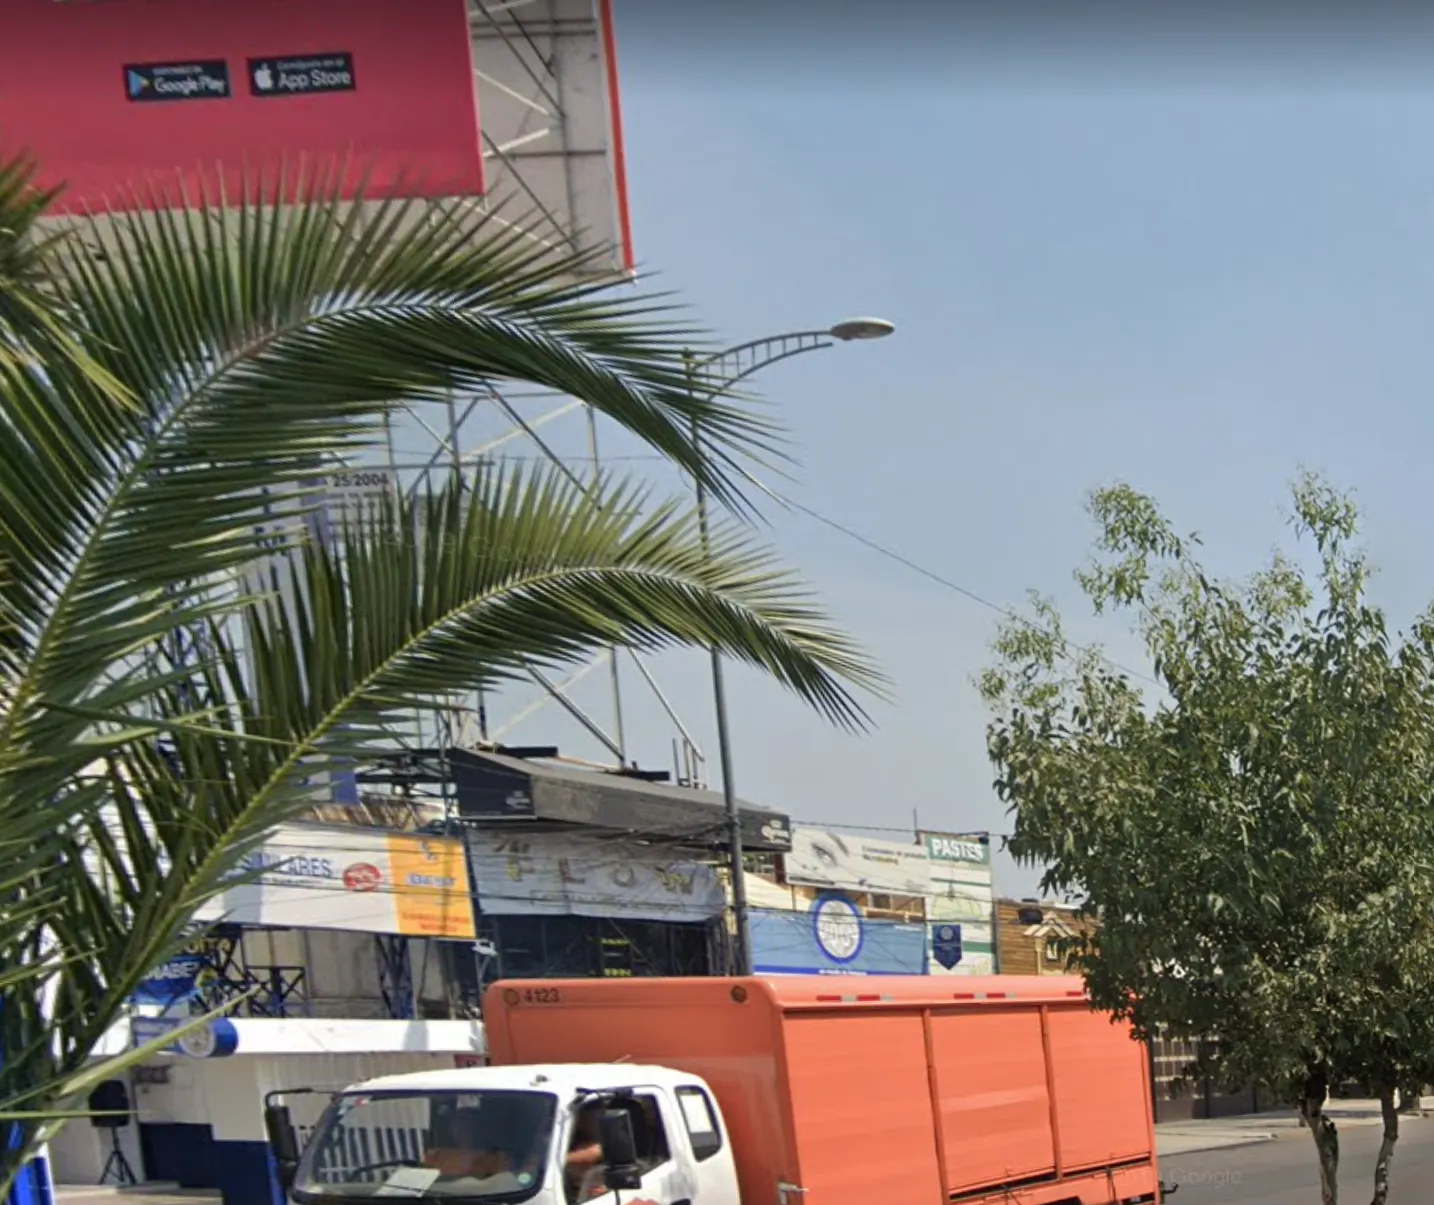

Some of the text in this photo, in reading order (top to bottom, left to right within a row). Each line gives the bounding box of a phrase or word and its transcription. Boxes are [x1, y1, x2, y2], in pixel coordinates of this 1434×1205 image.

[153, 75, 226, 95] Google Play
[279, 68, 352, 91] App Store
[931, 838, 985, 860] PASTES
